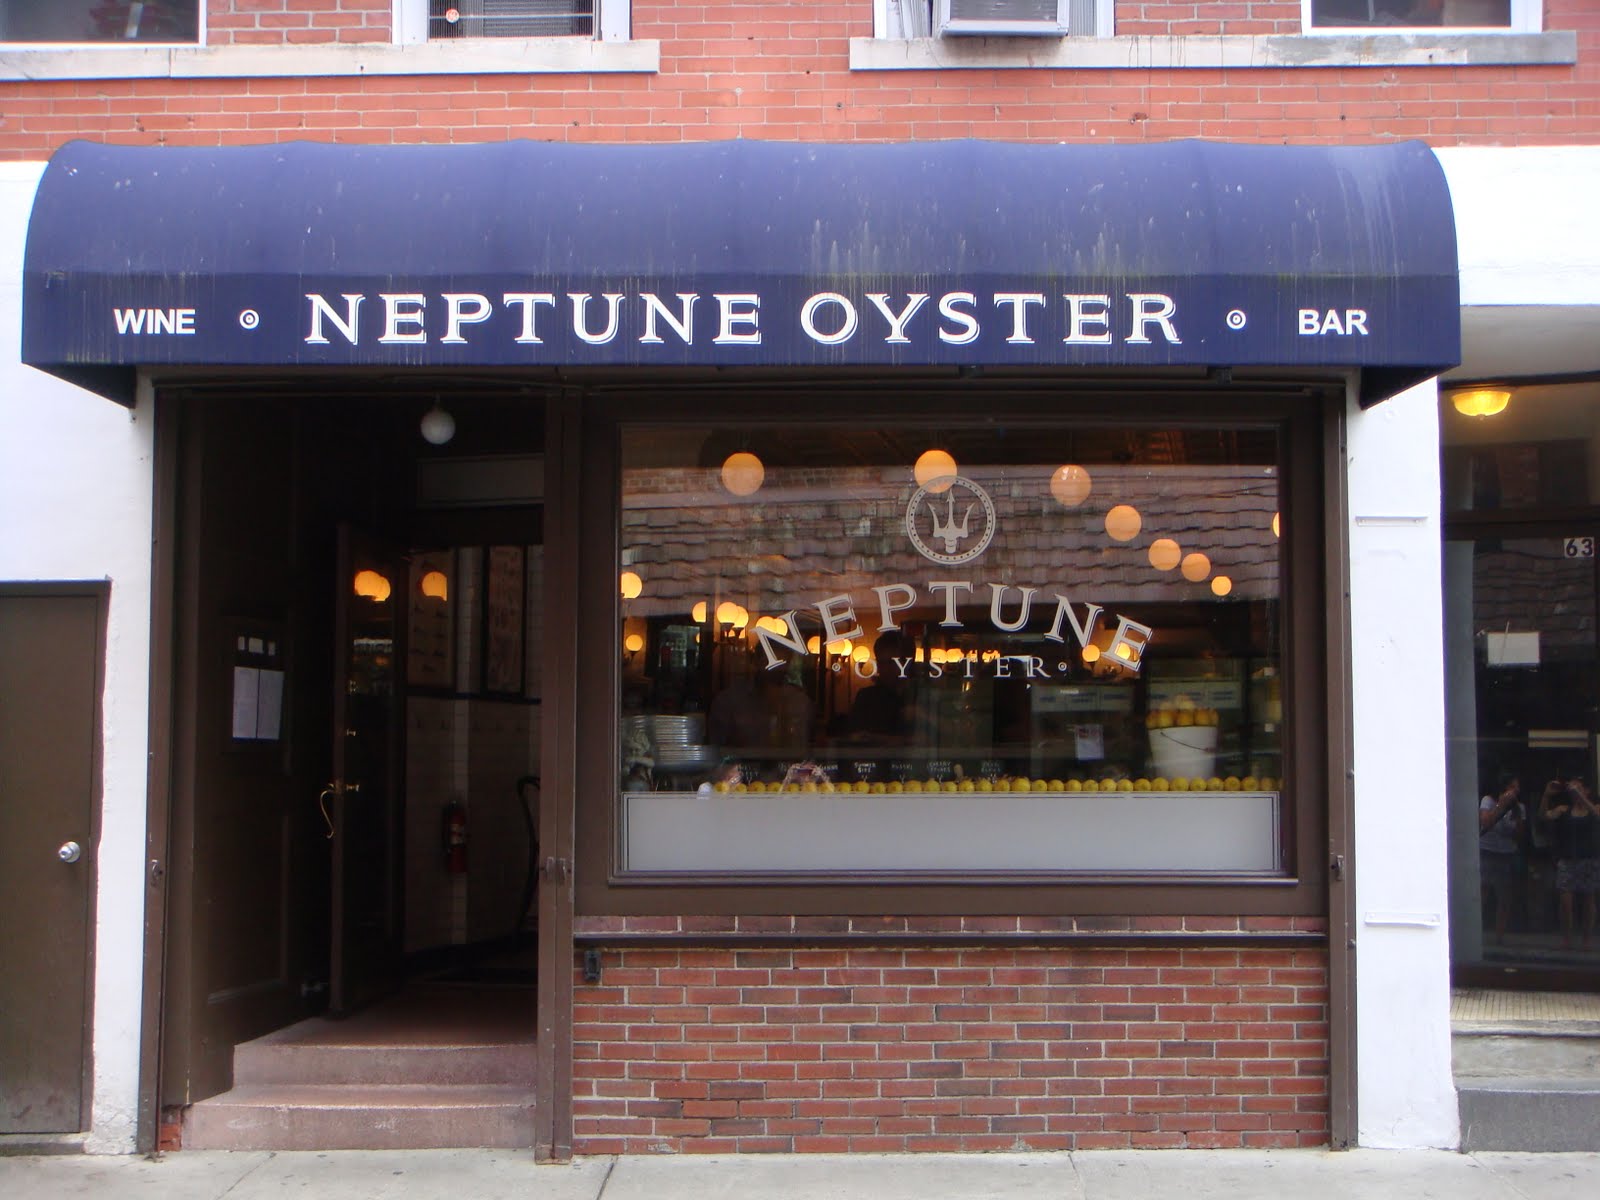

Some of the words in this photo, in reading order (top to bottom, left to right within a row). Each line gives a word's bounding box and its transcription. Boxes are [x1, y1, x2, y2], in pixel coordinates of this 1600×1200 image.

[114, 309, 196, 335] WINE
[305, 293, 762, 344] NEPTUNE
[800, 292, 1182, 344] OYSTER
[1298, 309, 1369, 335] BAR
[1566, 538, 1593, 556] 63
[755, 581, 1153, 672] NEPTUNE
[856, 657, 1051, 678] OYSTER
